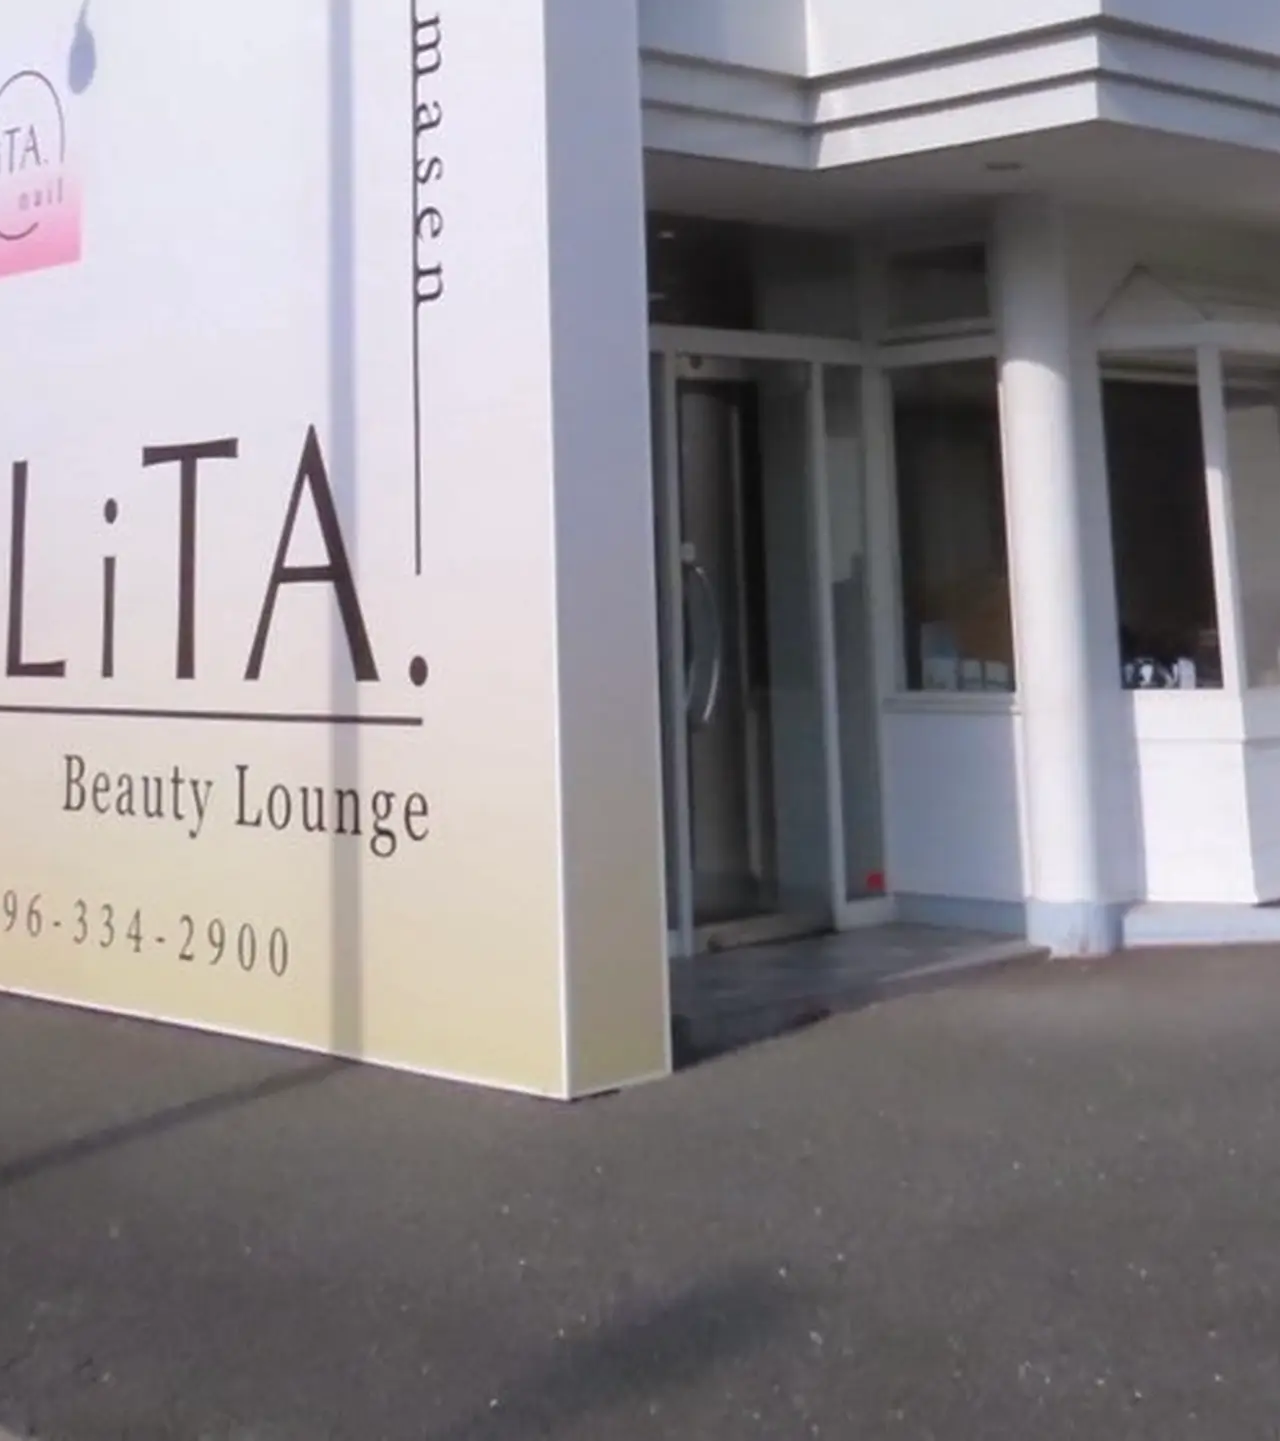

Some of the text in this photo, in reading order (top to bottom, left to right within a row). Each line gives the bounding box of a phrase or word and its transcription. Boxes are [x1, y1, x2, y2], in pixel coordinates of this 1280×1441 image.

[6, 423, 429, 687] LiTA.
[62, 753, 431, 859] Beauty Lounge
